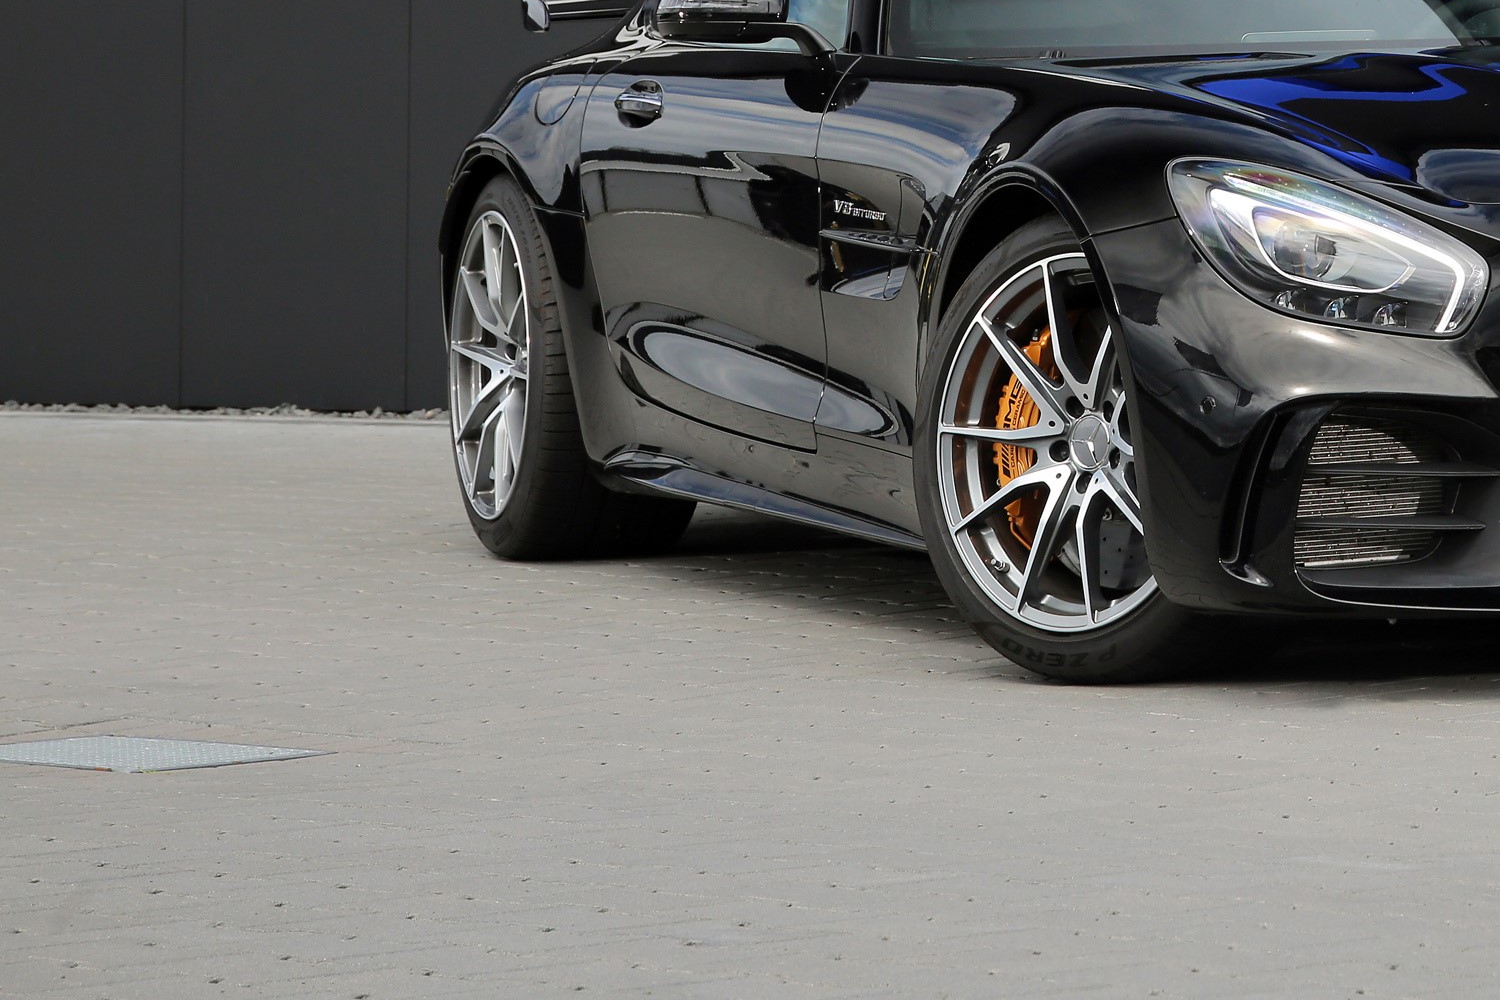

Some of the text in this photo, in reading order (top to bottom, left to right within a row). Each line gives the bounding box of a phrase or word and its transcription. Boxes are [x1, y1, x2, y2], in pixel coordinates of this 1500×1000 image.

[833, 200, 854, 215] V8
[1012, 389, 1026, 426] CERAMIC
[1001, 637, 1090, 668] ZERO
